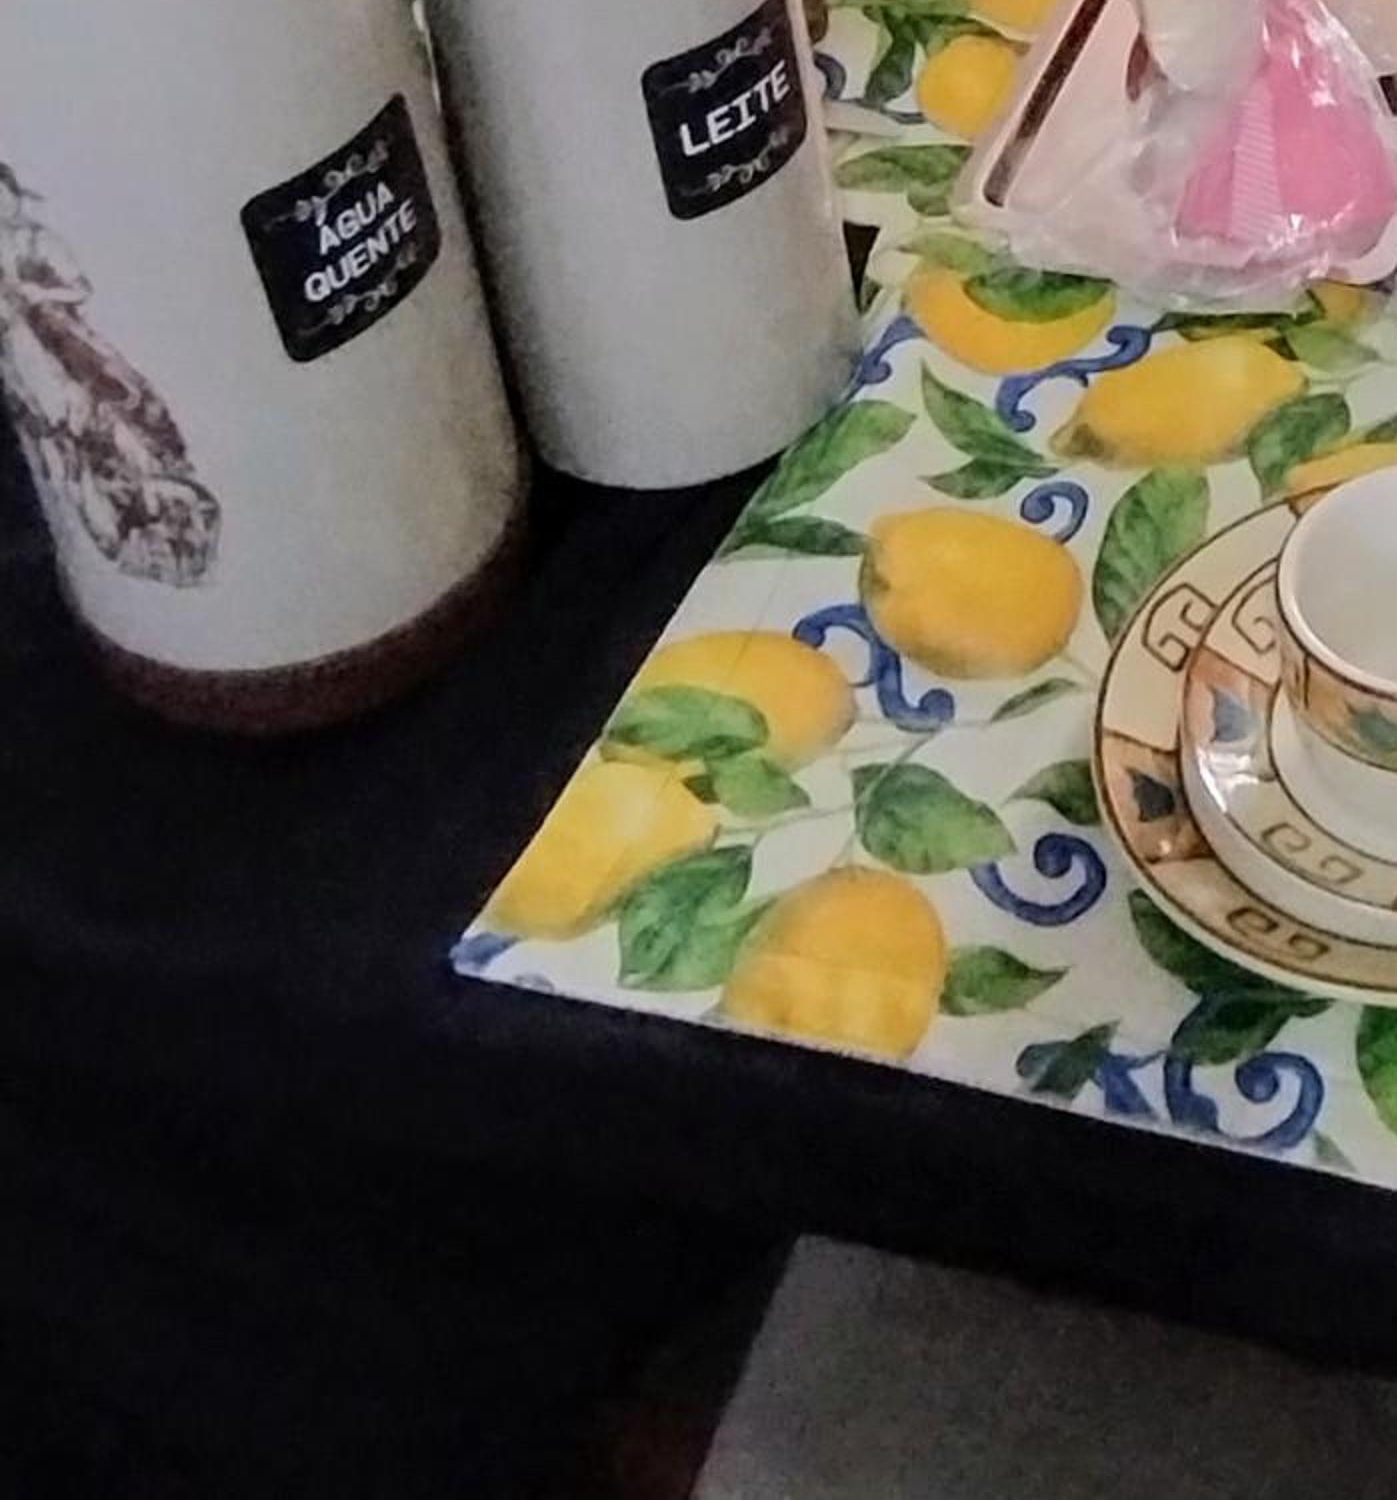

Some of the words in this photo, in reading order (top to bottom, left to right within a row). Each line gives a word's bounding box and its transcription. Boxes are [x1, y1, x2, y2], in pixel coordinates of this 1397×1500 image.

[679, 59, 790, 157] LEITE
[304, 196, 417, 302] QUENTE
[316, 181, 395, 256] ÁGUA
